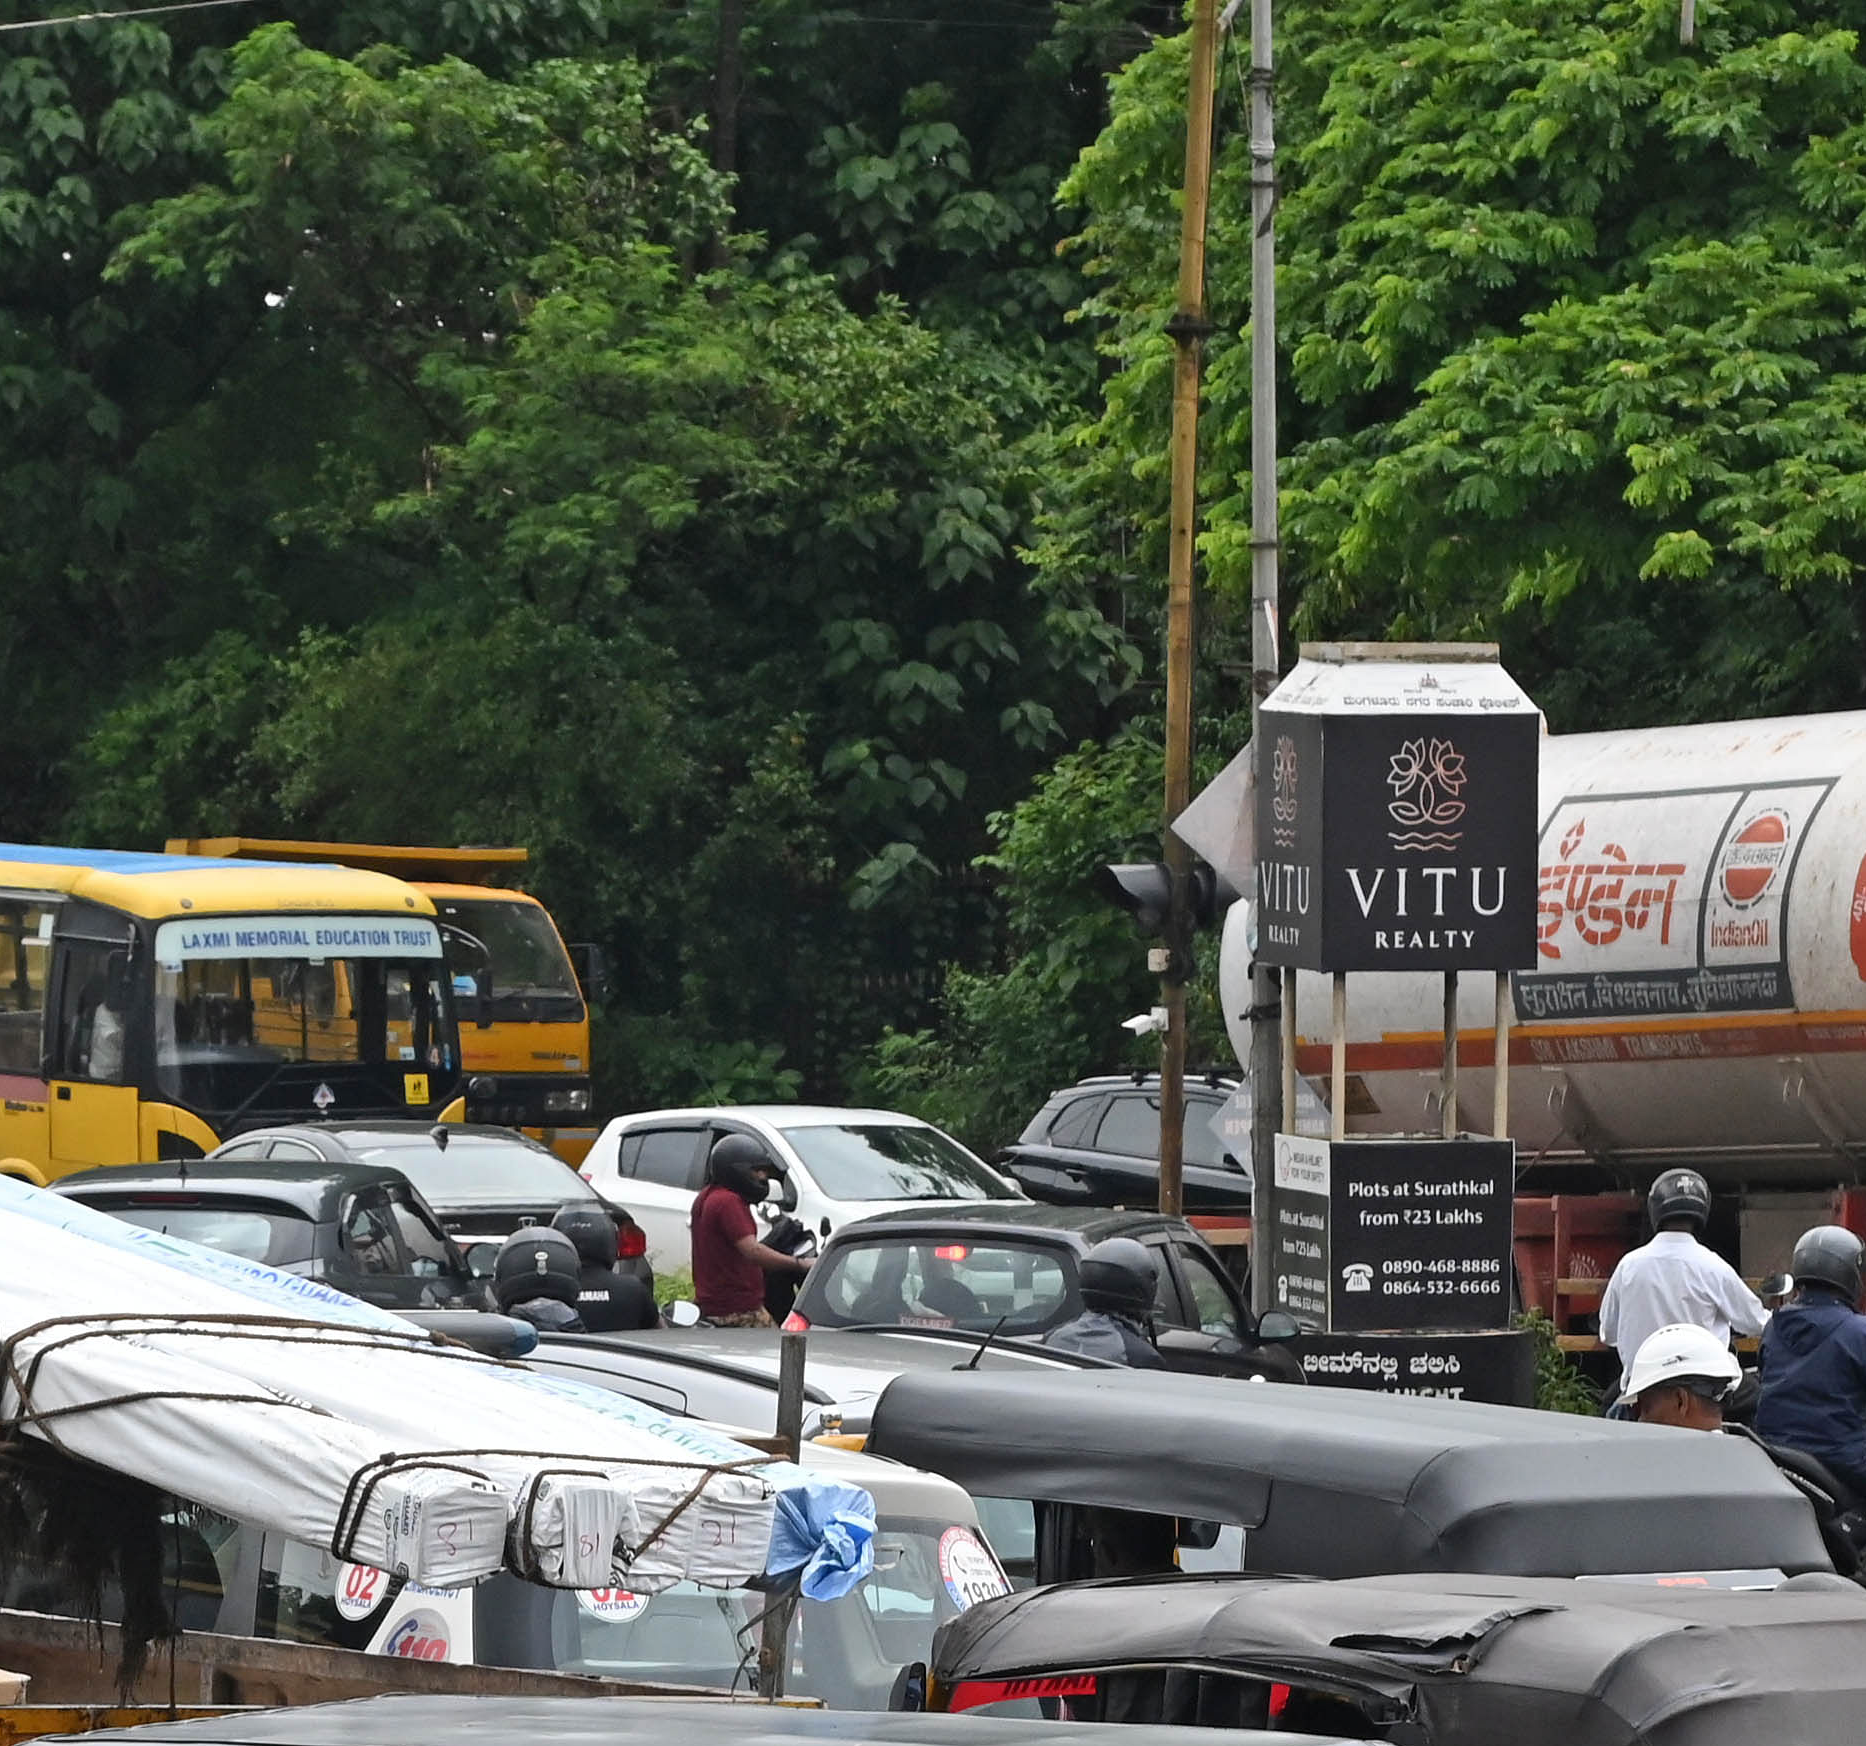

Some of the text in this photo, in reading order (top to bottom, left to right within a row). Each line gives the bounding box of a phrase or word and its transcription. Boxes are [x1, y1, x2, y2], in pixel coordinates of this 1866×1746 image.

[1261, 861, 1310, 914] VITU
[1345, 866, 1507, 919] VITU
[1268, 924, 1300, 946] REALTY
[1711, 907, 1769, 948] IndianOil
[182, 929, 433, 950] LAXMI MEMORIAL EDUCATION TRUST
[1375, 930, 1476, 949] REALTY
[1348, 1179, 1494, 1198] Plots at Surathkal
[1359, 1208, 1484, 1226] from ₹23 Lakhs
[1382, 1259, 1501, 1274] 0890-468-8886
[1383, 1280, 1501, 1294] 0864-532-6666
[345, 1564, 380, 1600] 02
[593, 1600, 640, 1612] HOYSALA
